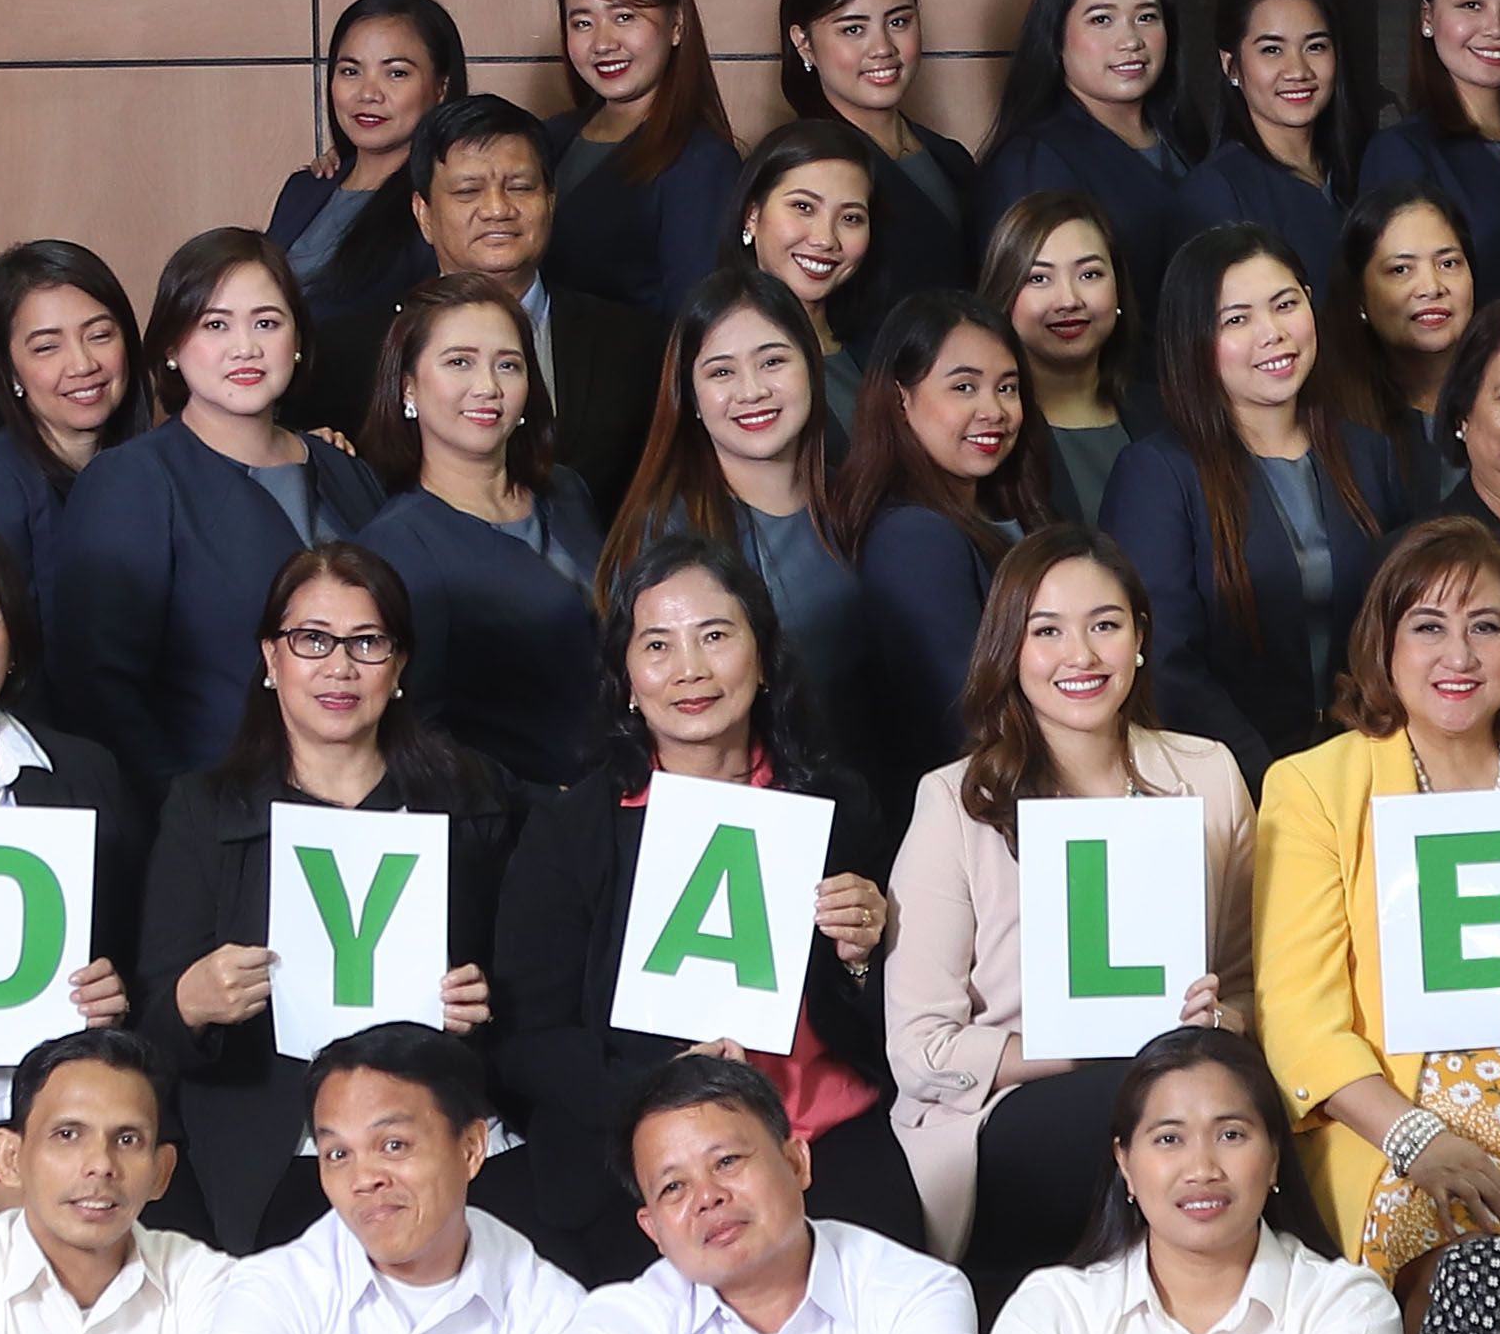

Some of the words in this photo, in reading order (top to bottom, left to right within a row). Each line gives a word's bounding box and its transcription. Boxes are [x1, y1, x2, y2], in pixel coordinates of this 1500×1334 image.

[294, 846, 420, 1006] Y
[644, 825, 776, 989] A
[1067, 839, 1165, 997] L
